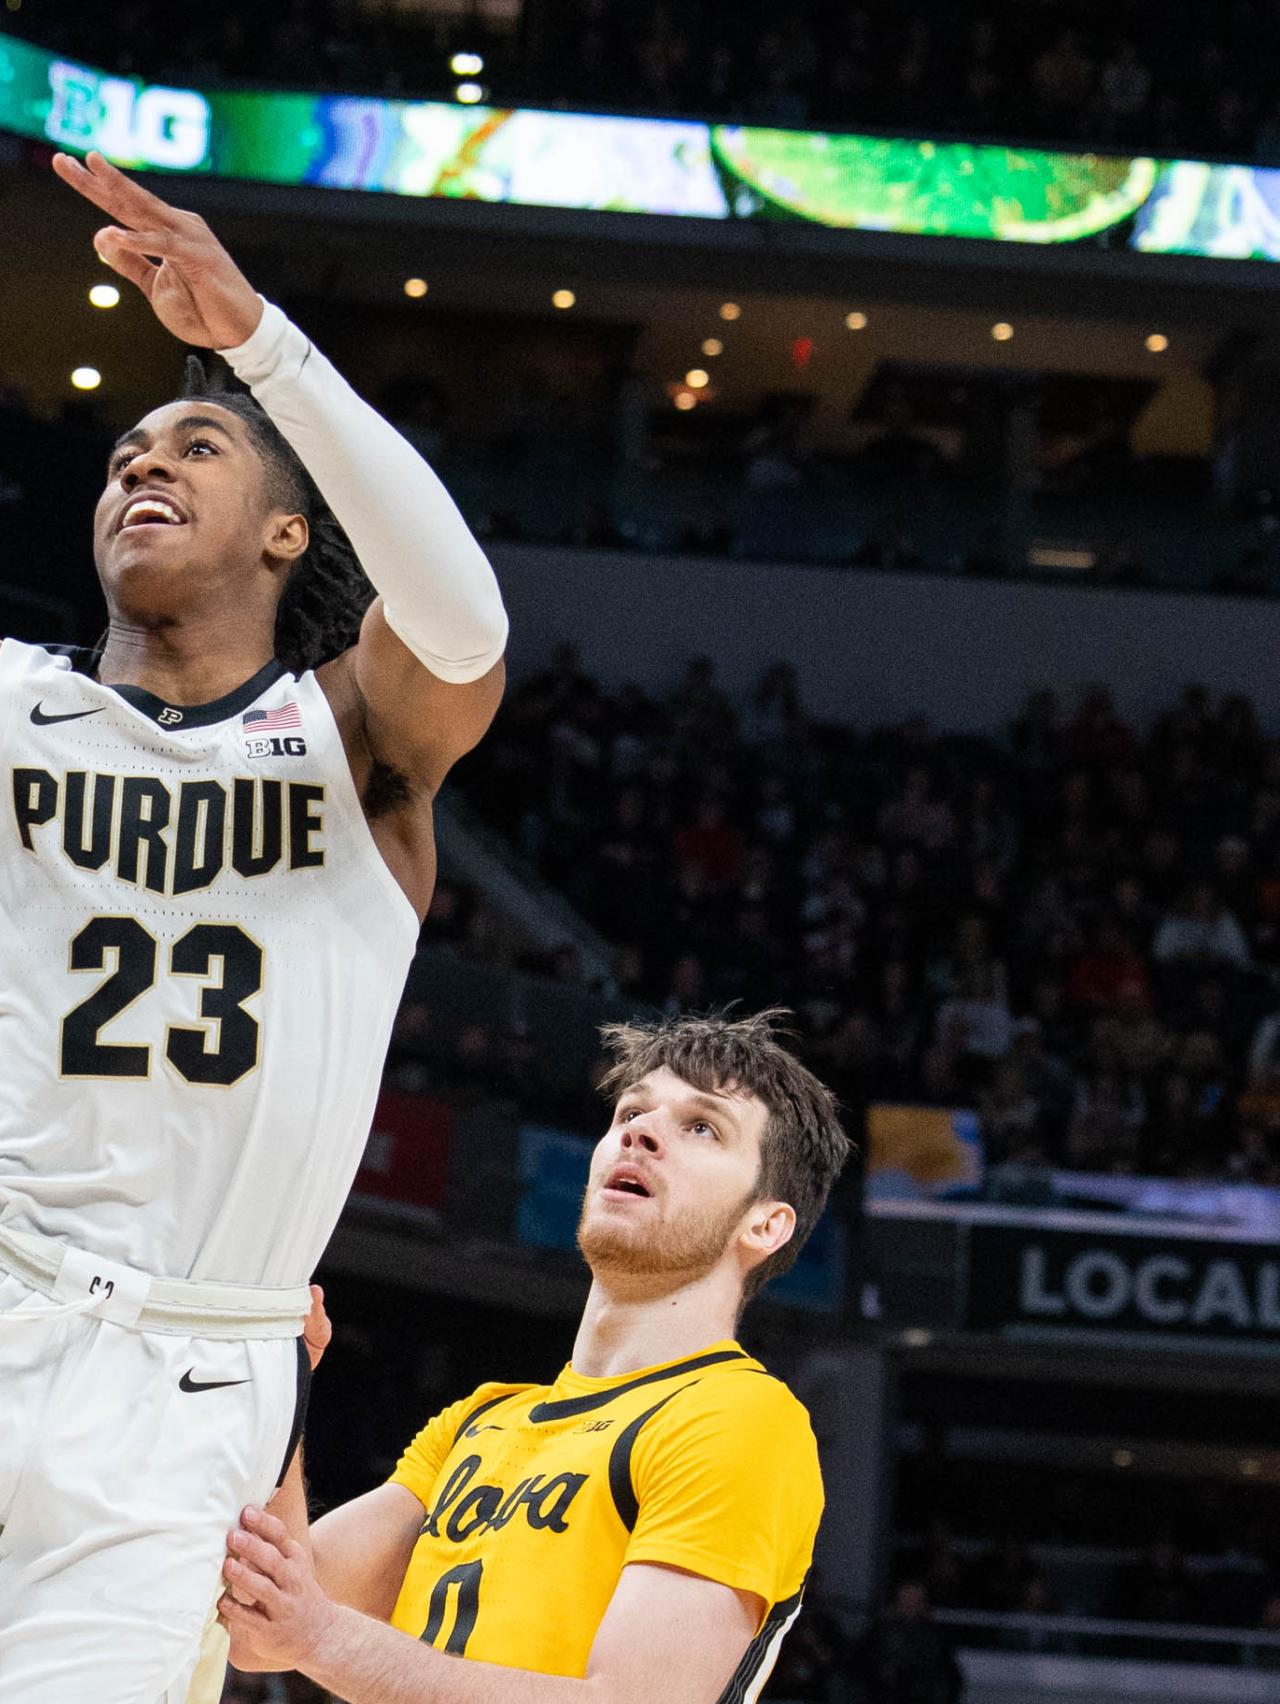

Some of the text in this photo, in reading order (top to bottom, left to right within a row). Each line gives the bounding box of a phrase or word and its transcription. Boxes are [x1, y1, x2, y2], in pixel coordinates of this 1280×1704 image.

[158, 707, 183, 725] P
[9, 767, 329, 898] PURDUE
[58, 915, 266, 1089] 23
